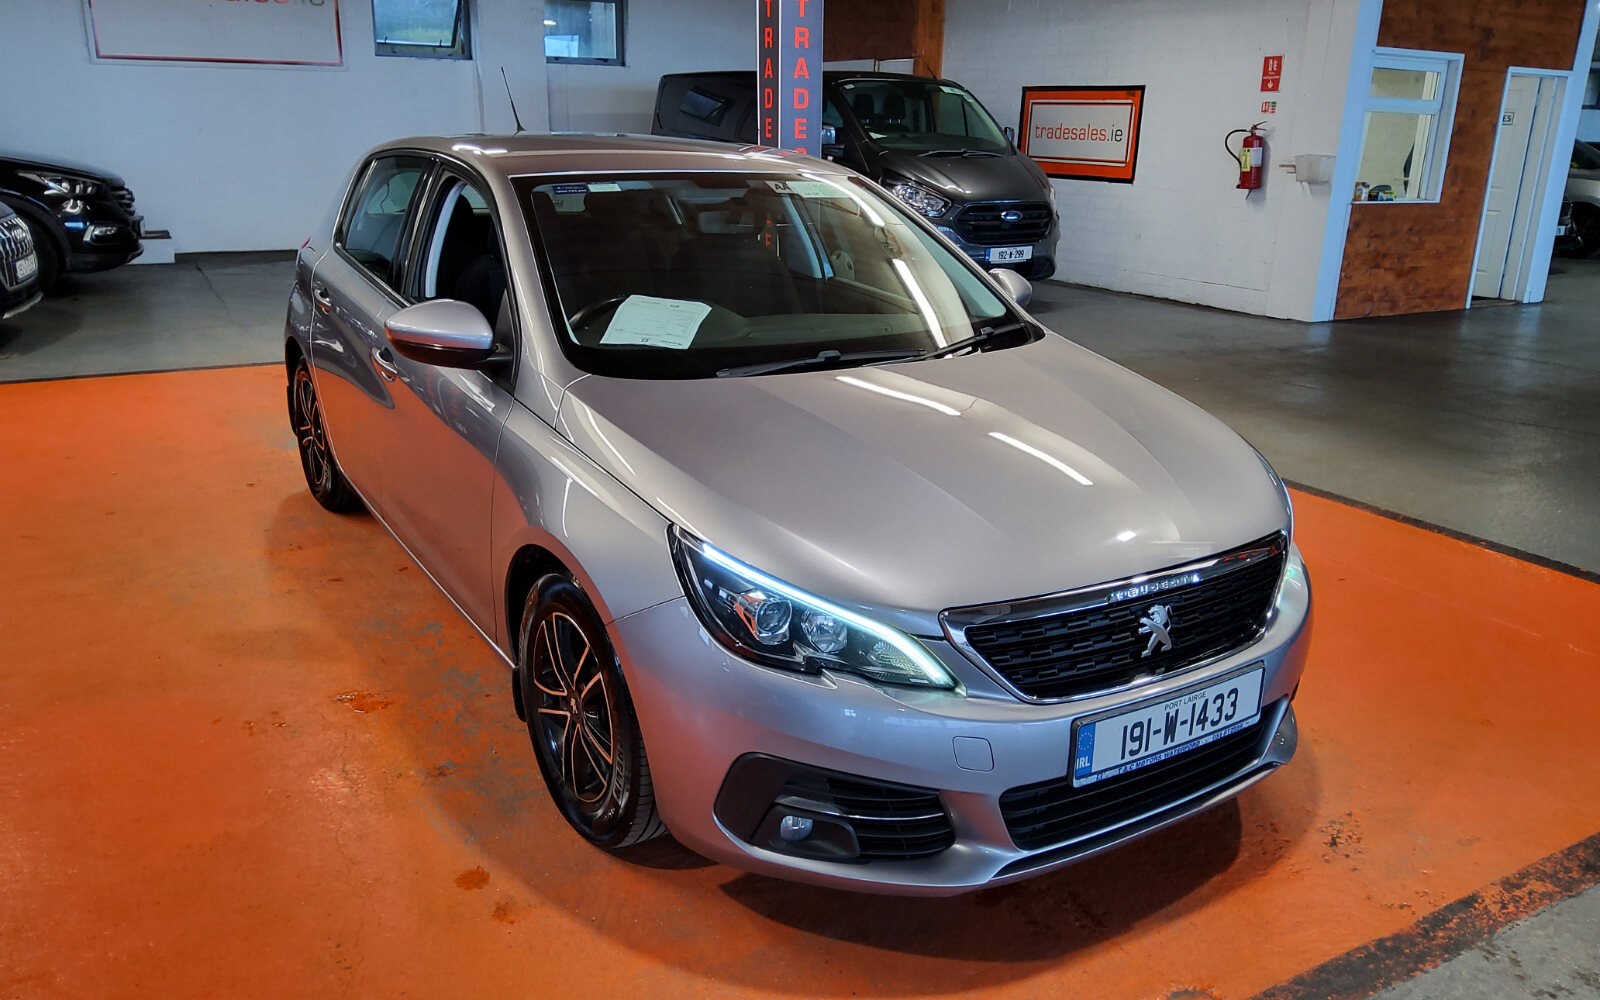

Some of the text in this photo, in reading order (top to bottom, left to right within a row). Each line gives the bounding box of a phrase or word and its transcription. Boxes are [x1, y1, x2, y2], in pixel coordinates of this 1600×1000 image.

[1034, 122, 1123, 142] tradesales.ie
[998, 249, 1025, 260] 192-W-299
[1164, 699, 1183, 711] PORT
[1121, 687, 1239, 760] 191-W-1433
[1076, 755, 1091, 770] IRL
